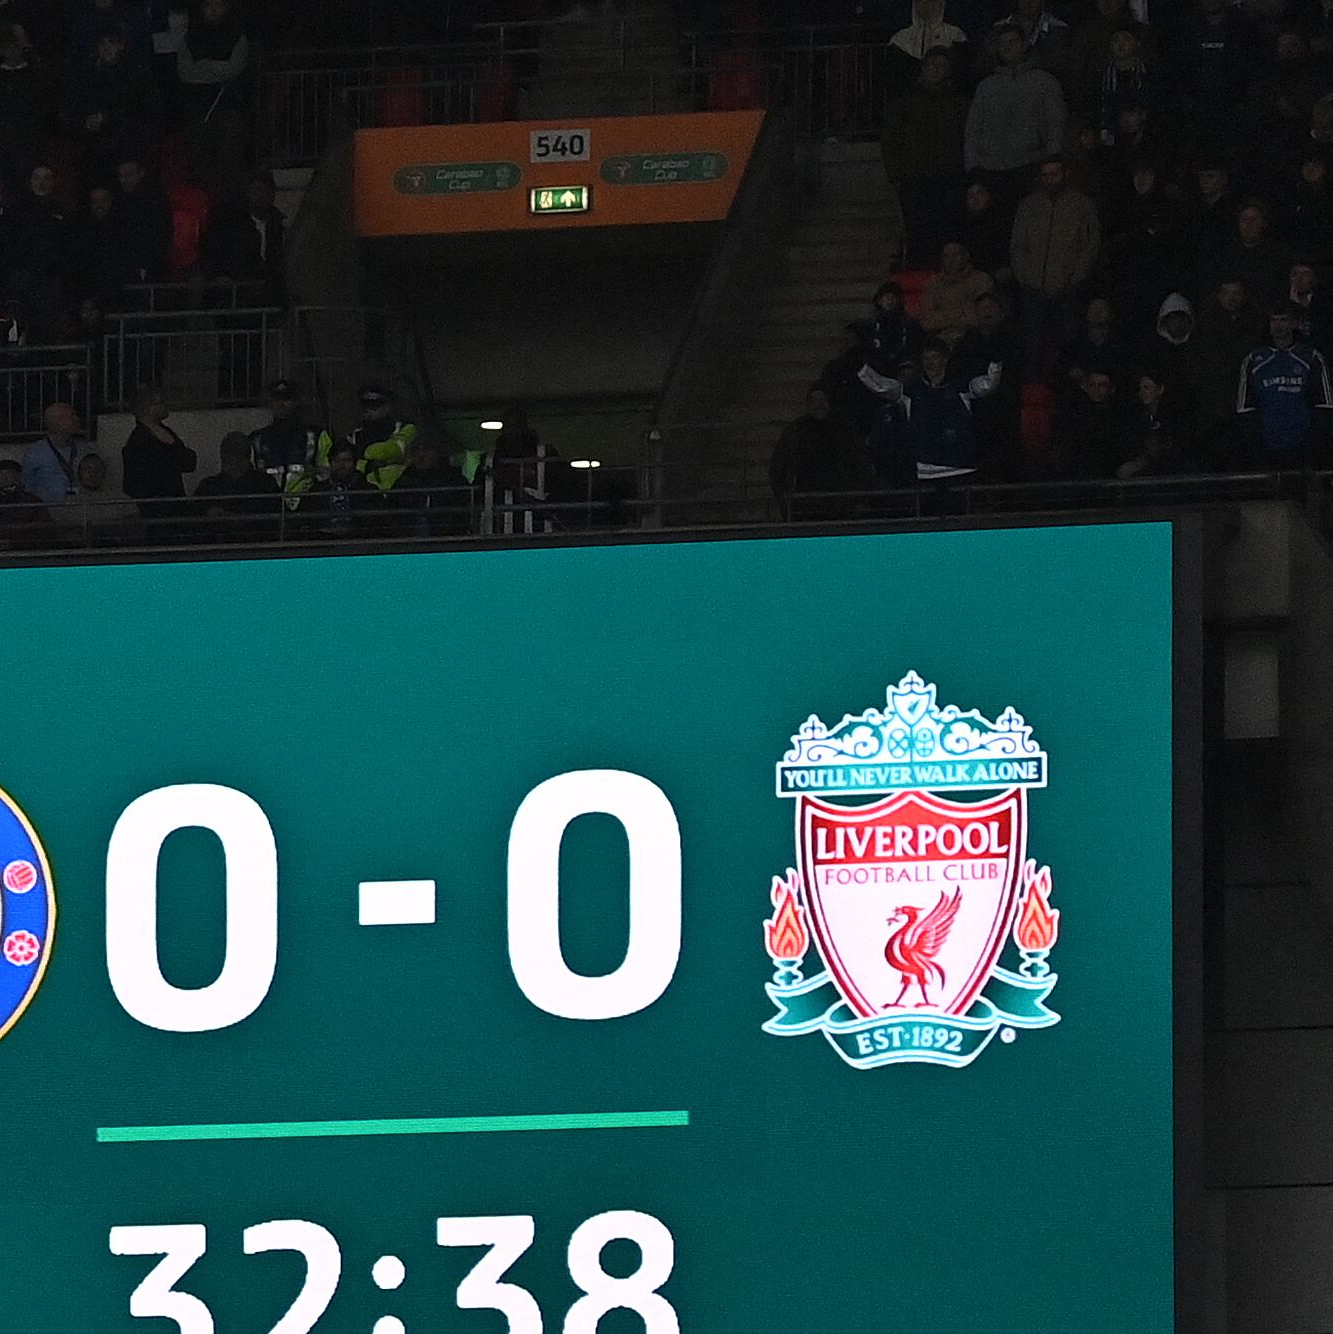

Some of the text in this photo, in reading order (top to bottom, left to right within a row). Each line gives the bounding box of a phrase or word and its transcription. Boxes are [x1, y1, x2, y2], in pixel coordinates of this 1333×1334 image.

[536, 134, 585, 158] 540
[784, 761, 1039, 788] YOU'LL NEVER WALK ALONE
[815, 821, 1009, 860] LIVERPOOL
[824, 862, 999, 885] FOOTBALL CLUB
[106, 784, 279, 1034] 0
[508, 770, 683, 1021] 0
